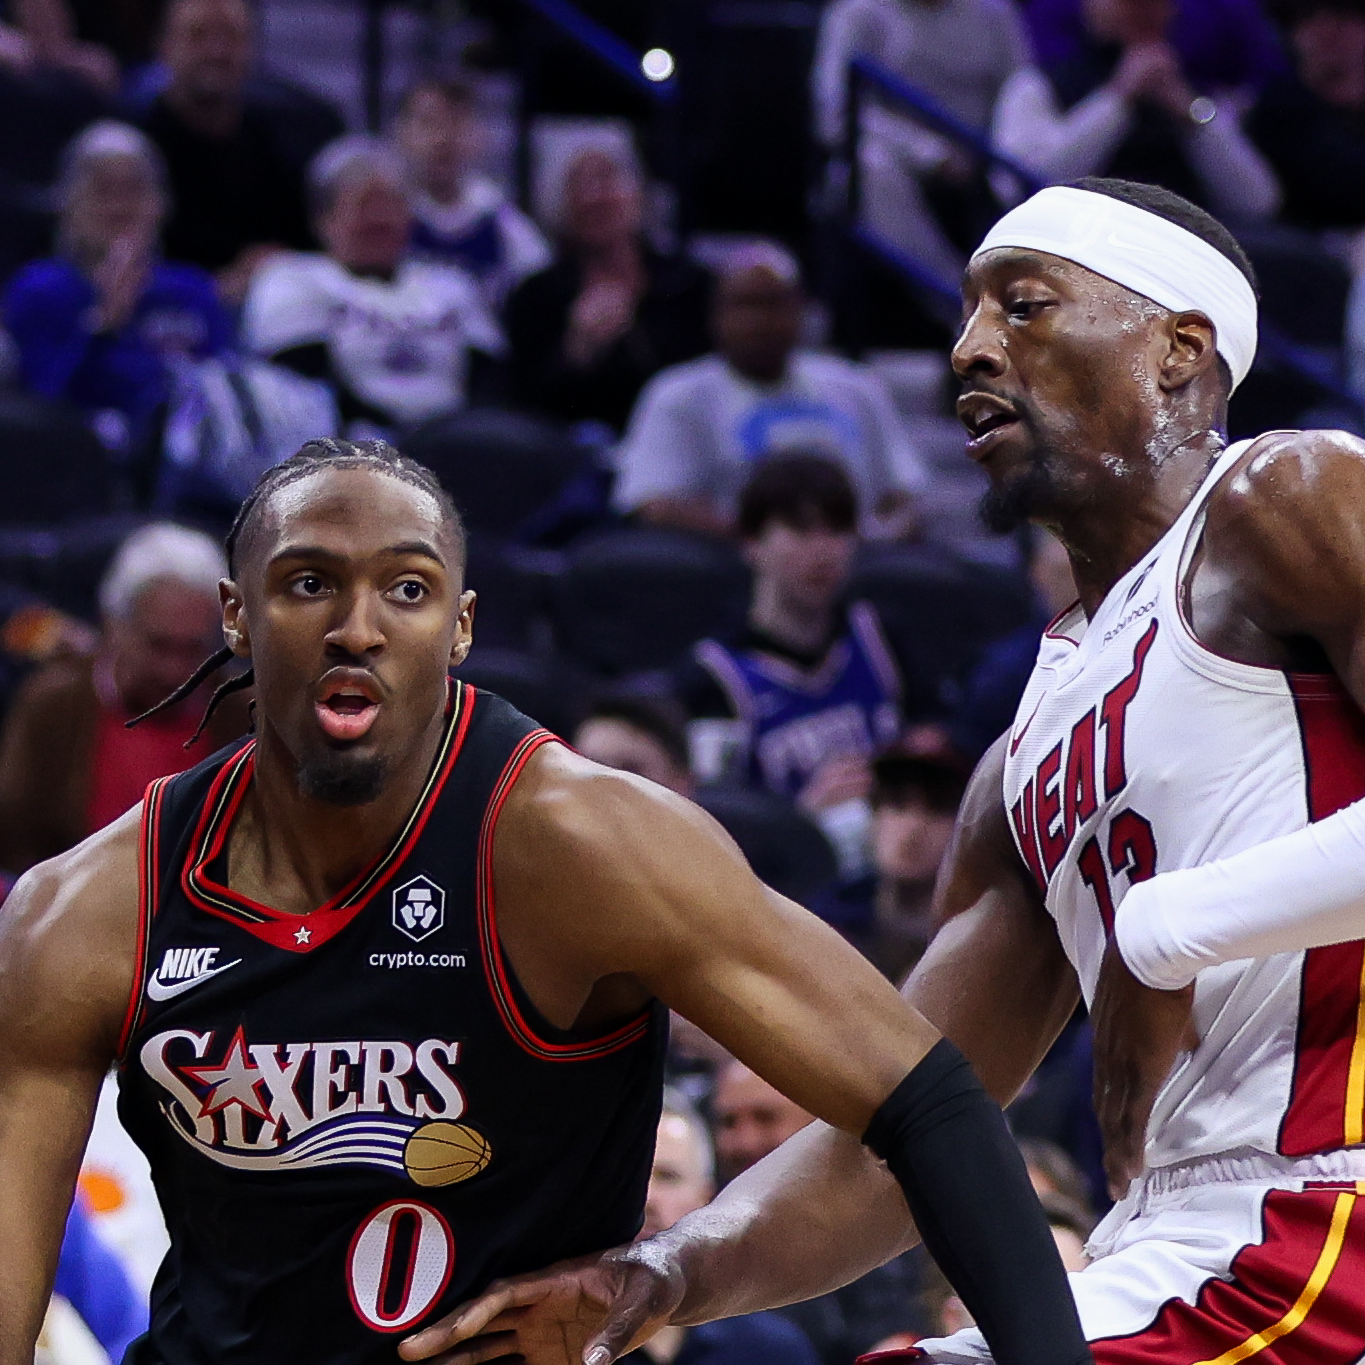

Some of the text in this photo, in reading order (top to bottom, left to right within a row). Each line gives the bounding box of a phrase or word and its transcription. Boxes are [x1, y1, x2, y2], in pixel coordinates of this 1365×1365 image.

[159, 947, 220, 980] NIKE
[369, 950, 466, 969] crypto.com
[345, 1200, 456, 1334] 0
